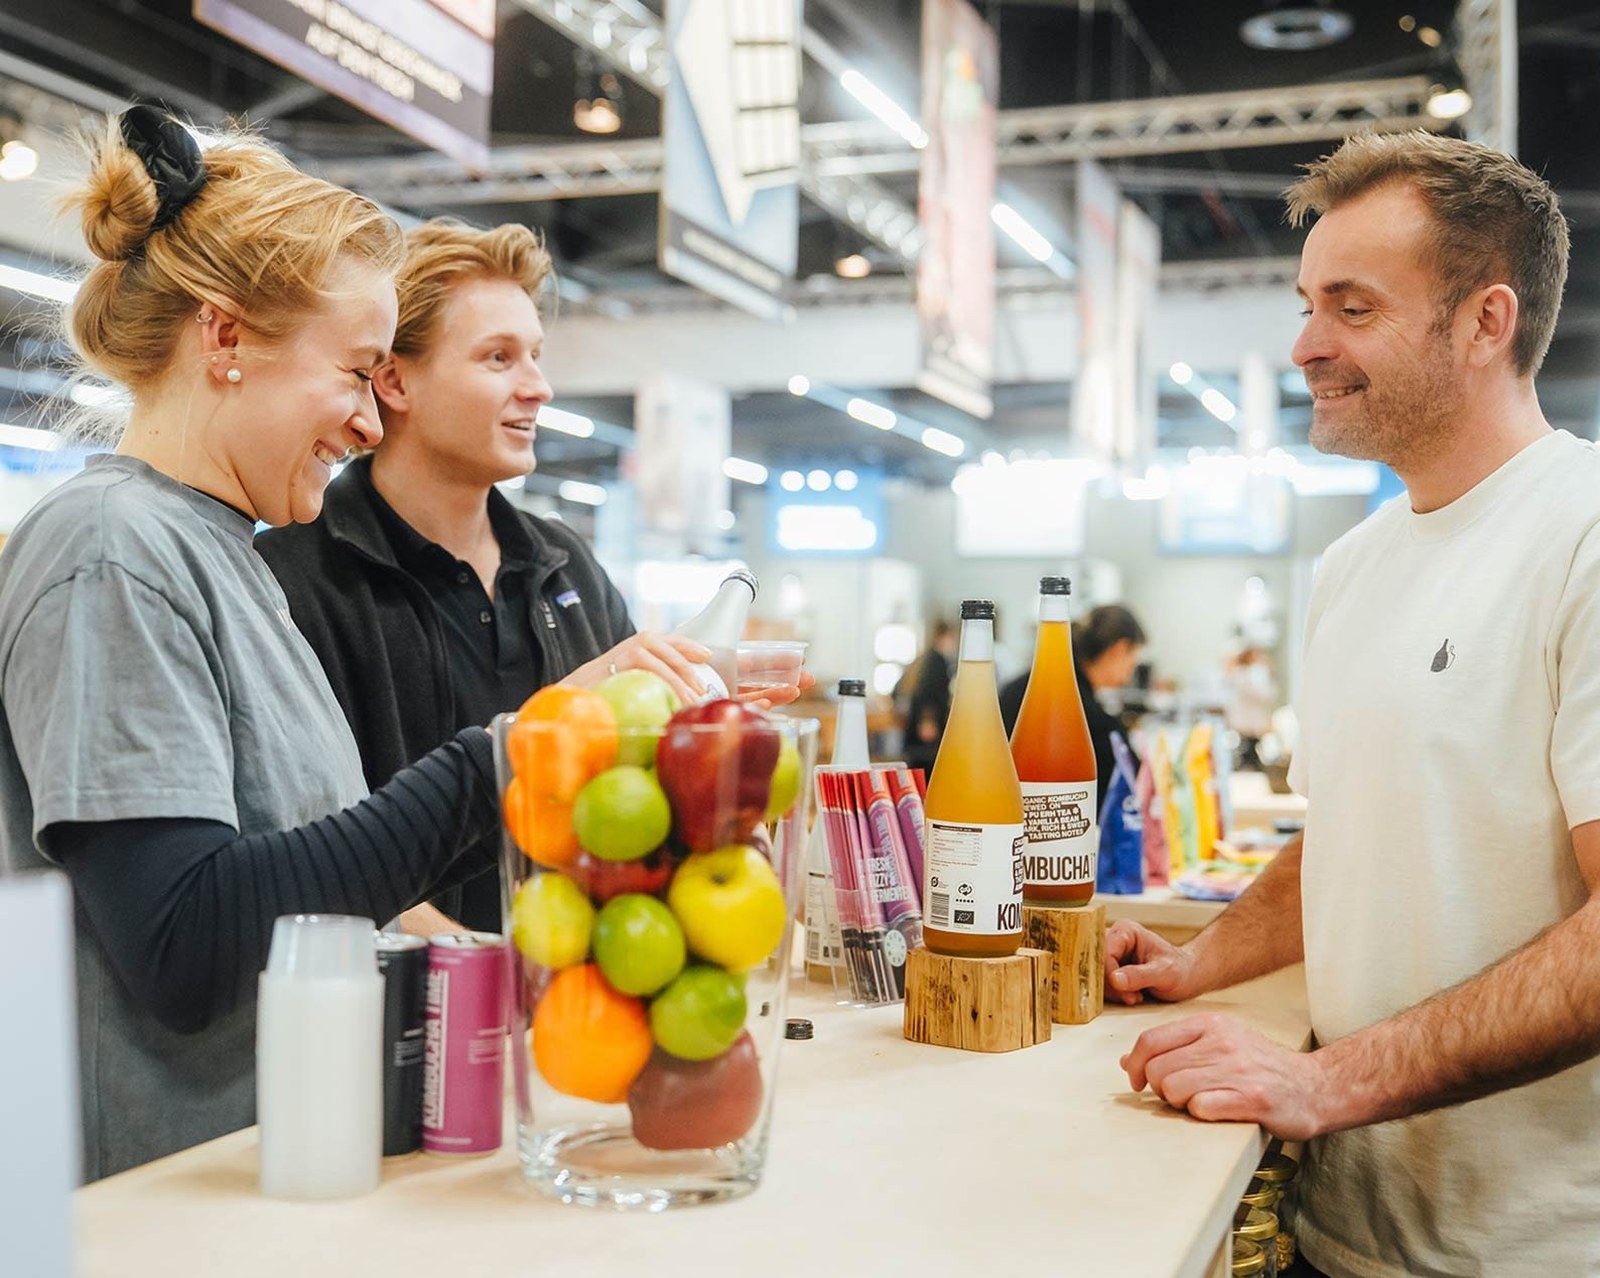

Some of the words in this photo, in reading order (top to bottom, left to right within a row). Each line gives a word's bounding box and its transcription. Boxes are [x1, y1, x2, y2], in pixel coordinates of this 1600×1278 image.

[1048, 792, 1087, 803] KOMBUCHA
[1057, 808, 1072, 817] TEA
[1027, 817, 1060, 826] VANILLA
[1060, 815, 1080, 823] BEAN
[1041, 823, 1060, 832] RICH
[1067, 820, 1088, 829] SWEET
[1029, 831, 1061, 840] TASTING
[1061, 828, 1084, 838] NOTES
[1023, 854, 1090, 881] MBUCHA
